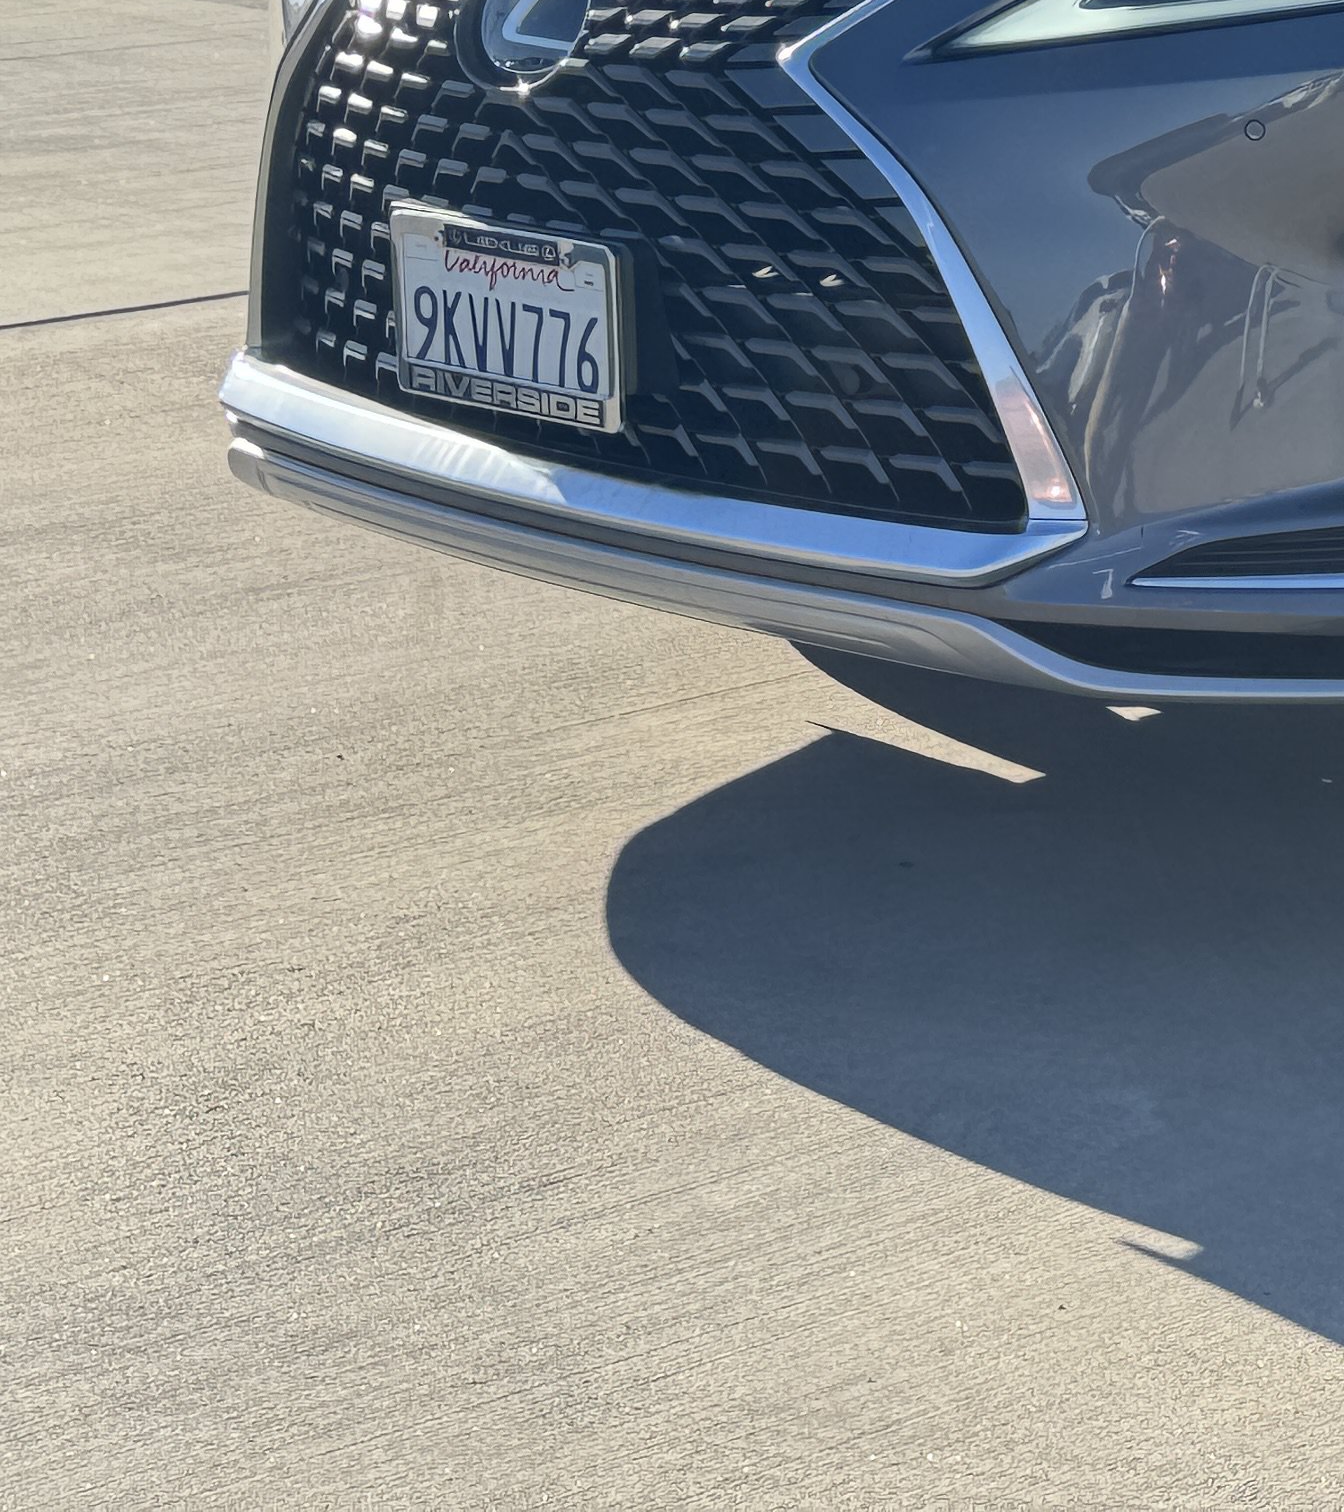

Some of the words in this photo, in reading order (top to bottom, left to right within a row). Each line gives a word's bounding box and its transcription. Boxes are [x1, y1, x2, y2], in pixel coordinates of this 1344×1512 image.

[444, 250, 575, 291] California
[413, 285, 599, 392] 9KVV776
[411, 368, 602, 425] RIVERSIDE
